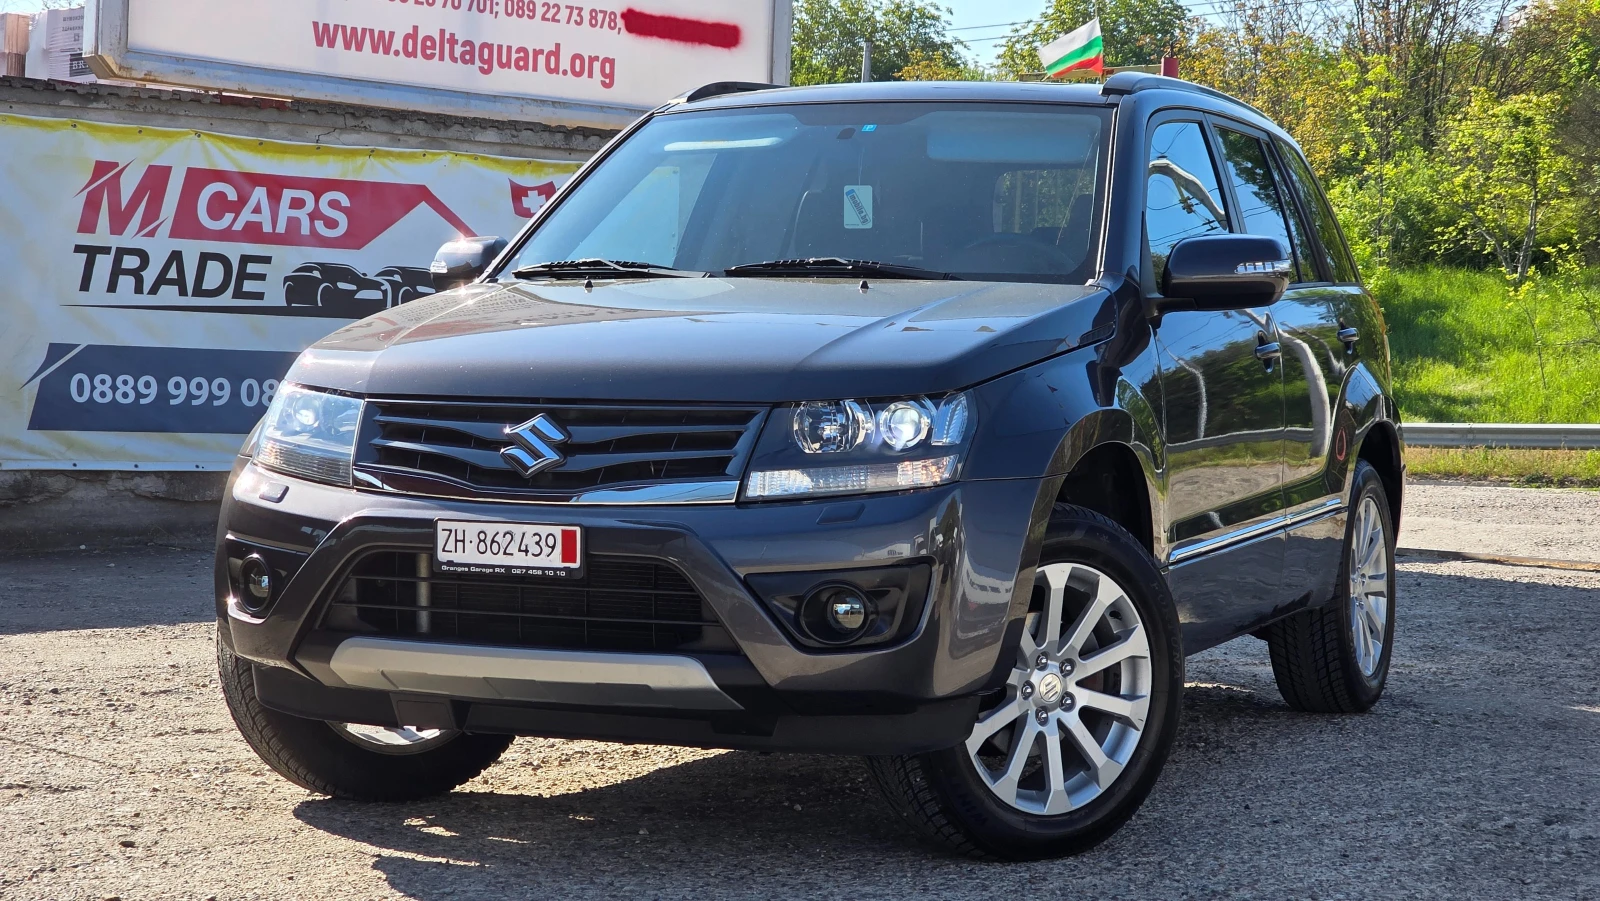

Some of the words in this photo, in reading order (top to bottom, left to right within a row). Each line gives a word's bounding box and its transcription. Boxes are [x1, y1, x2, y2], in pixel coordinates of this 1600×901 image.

[504, 0, 536, 20] 089
[541, 2, 561, 23] 22
[565, 5, 584, 26] 73
[588, 8, 622, 35] 878,
[312, 20, 616, 89] www.deltaguard.org
[73, 158, 173, 239] M
[197, 181, 351, 243] CARS
[73, 244, 273, 301] TRADE
[70, 372, 157, 405] 0889
[167, 374, 231, 407] 999
[470, 566, 493, 574] Garage
